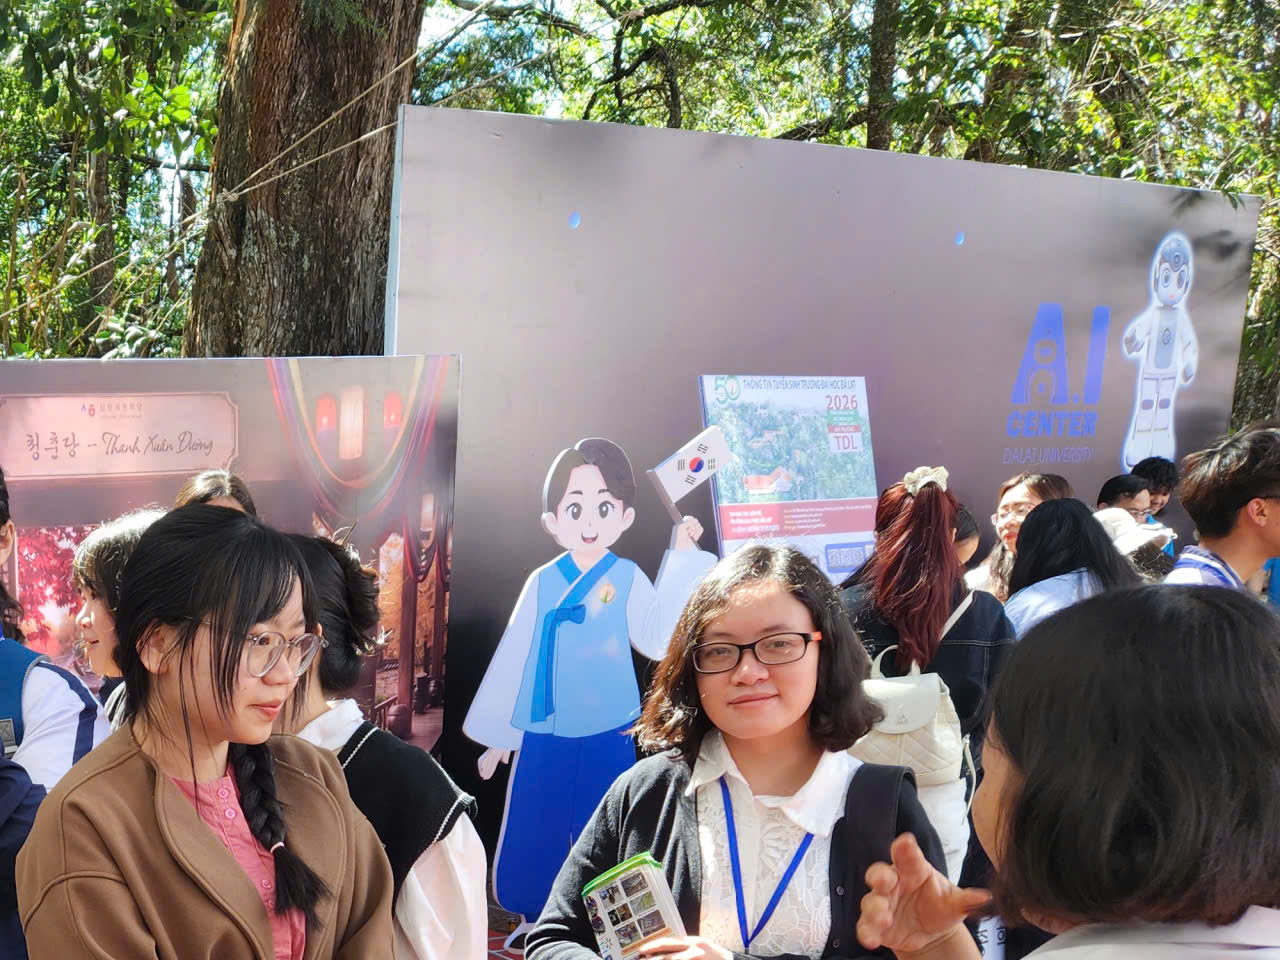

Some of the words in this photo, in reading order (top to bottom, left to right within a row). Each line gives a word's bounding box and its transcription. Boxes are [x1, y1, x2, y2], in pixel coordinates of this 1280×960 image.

[825, 394, 858, 410] 2026
[1006, 410, 1098, 438] CENTER
[101, 431, 141, 456] Thanh
[834, 435, 857, 450] TDL
